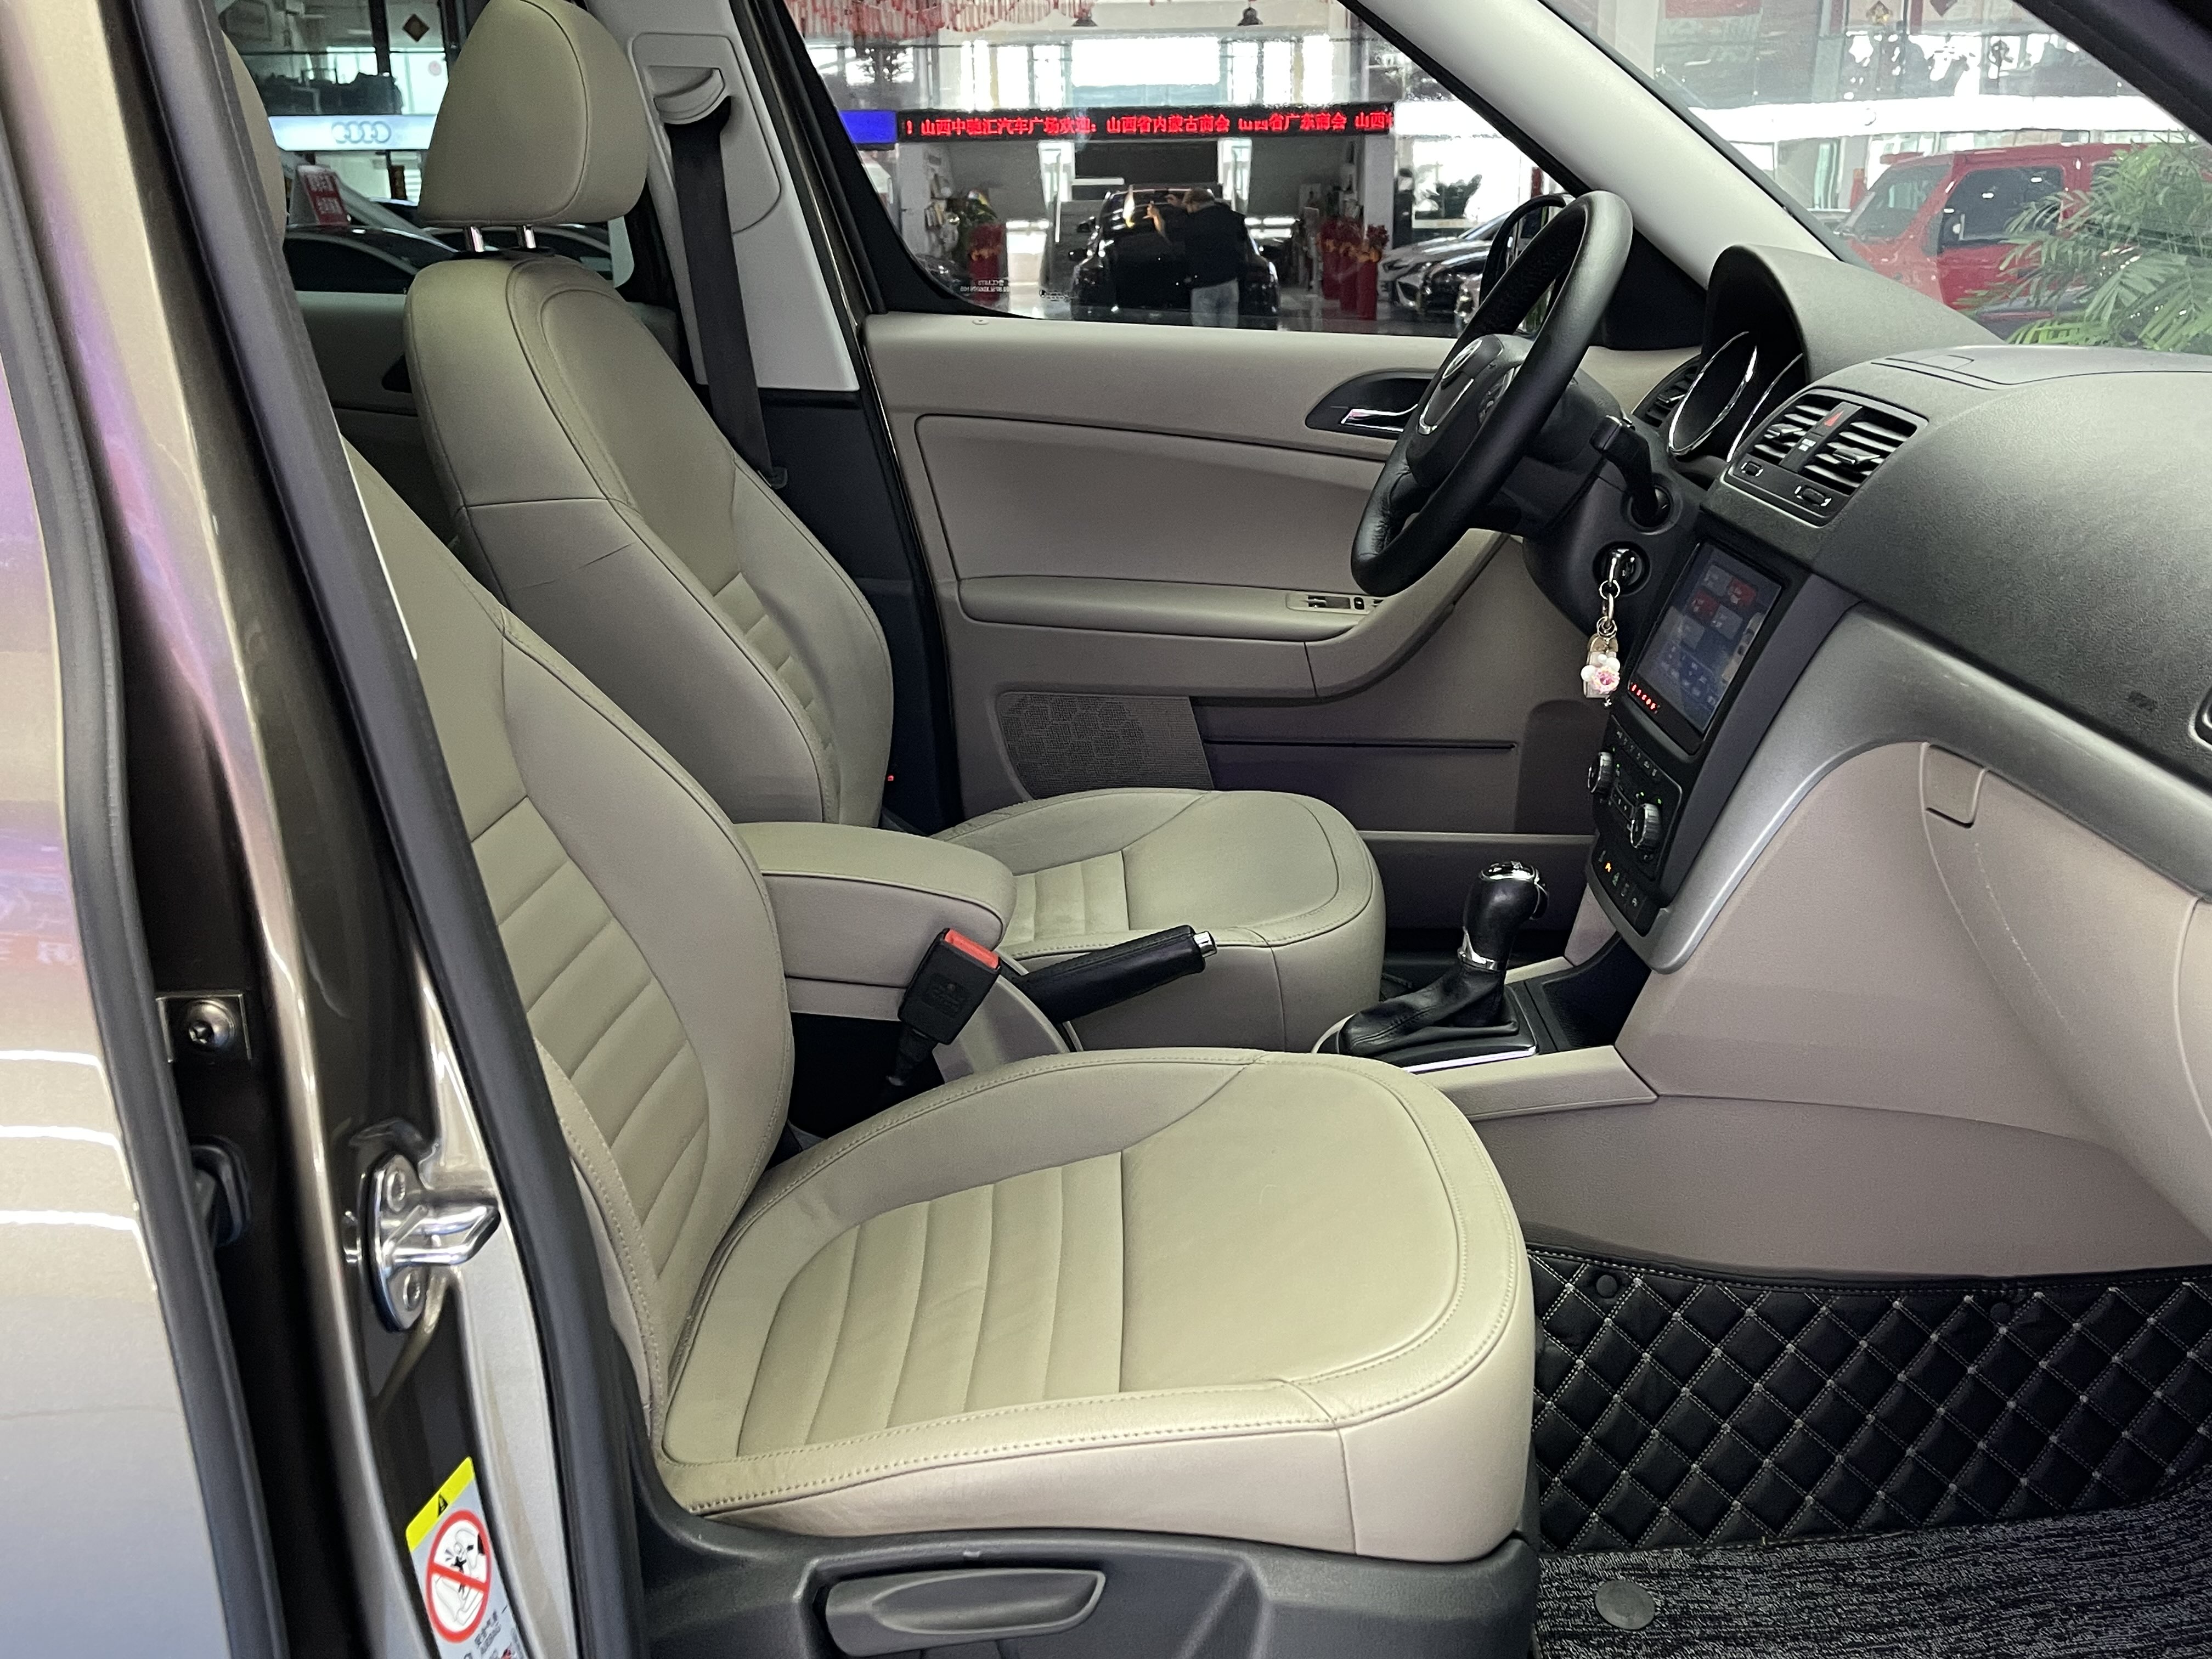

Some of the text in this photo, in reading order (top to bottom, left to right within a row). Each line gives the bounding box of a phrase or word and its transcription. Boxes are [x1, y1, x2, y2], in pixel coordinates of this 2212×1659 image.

[1107, 114, 1230, 134] 山西省内蒙古商会
